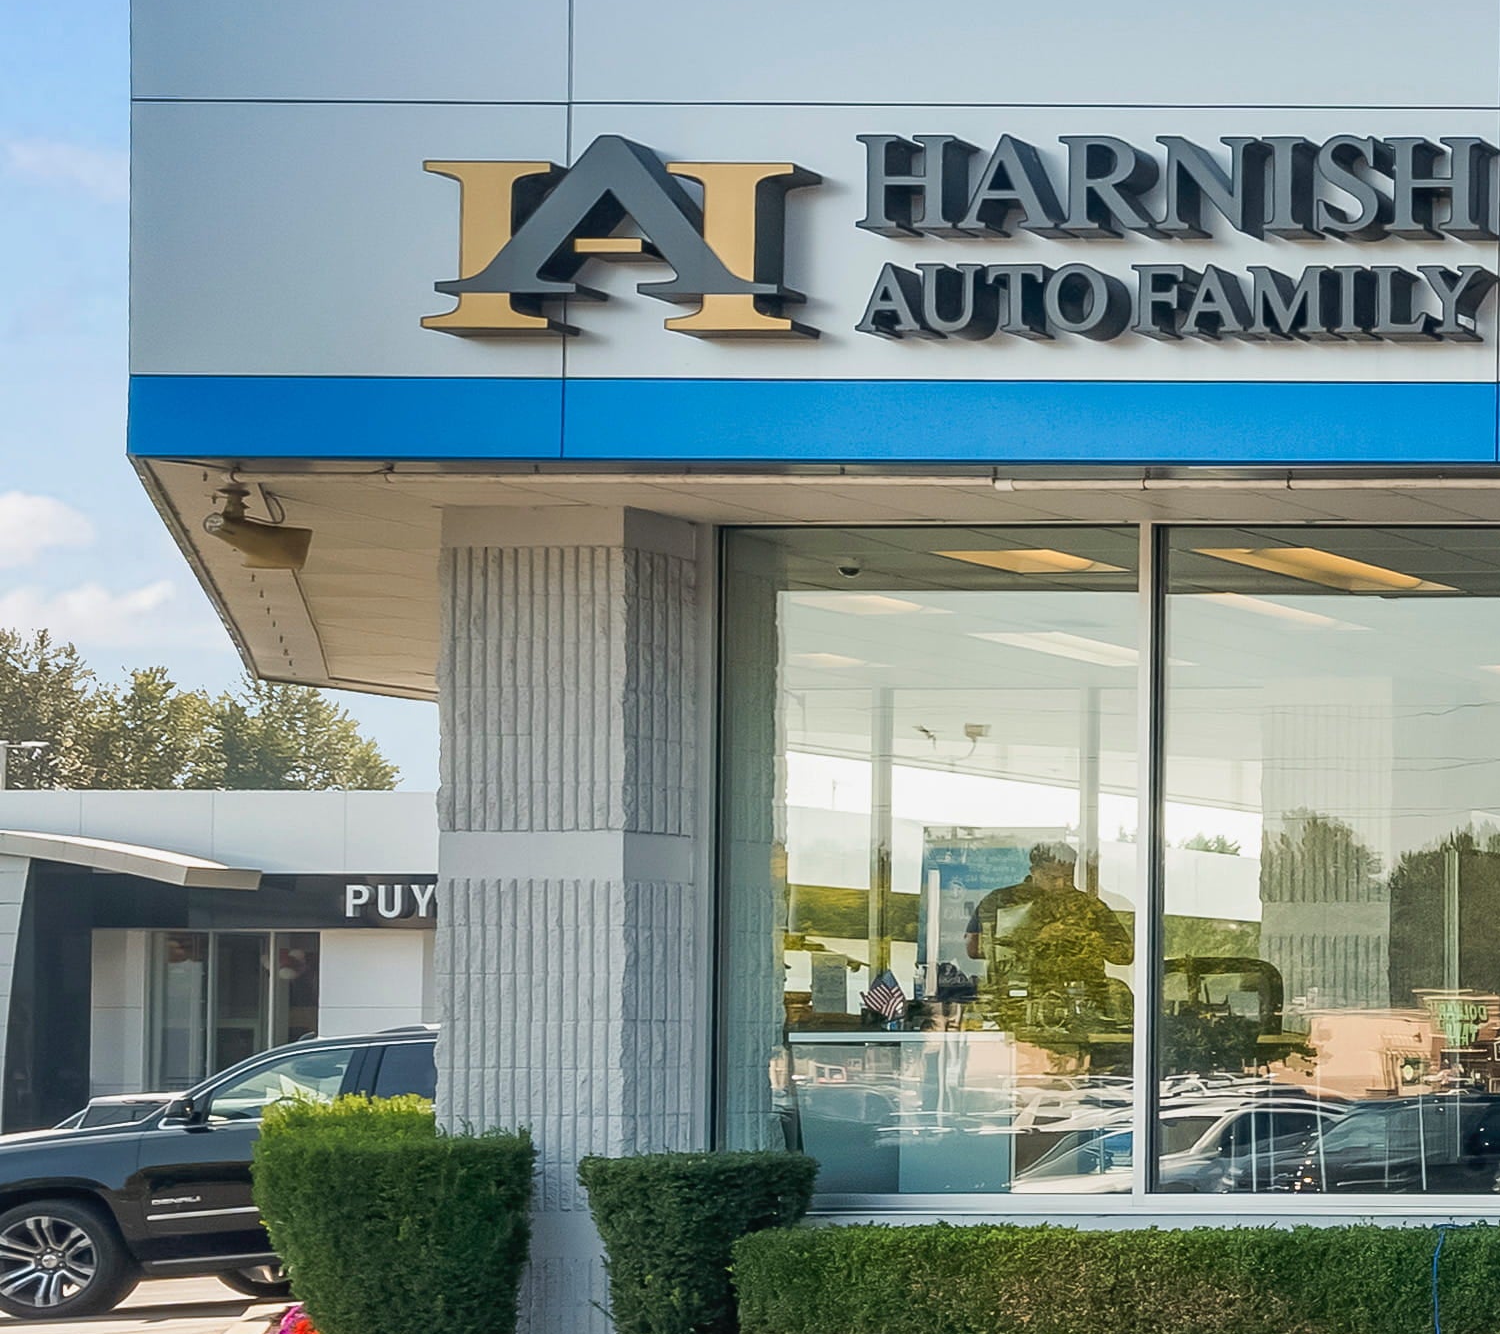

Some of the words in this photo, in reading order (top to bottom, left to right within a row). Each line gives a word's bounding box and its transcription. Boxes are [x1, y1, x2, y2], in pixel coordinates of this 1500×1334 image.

[855, 133, 1500, 242] HARNISH
[856, 263, 1131, 342] AUTO
[1131, 263, 1498, 343] FAMILY
